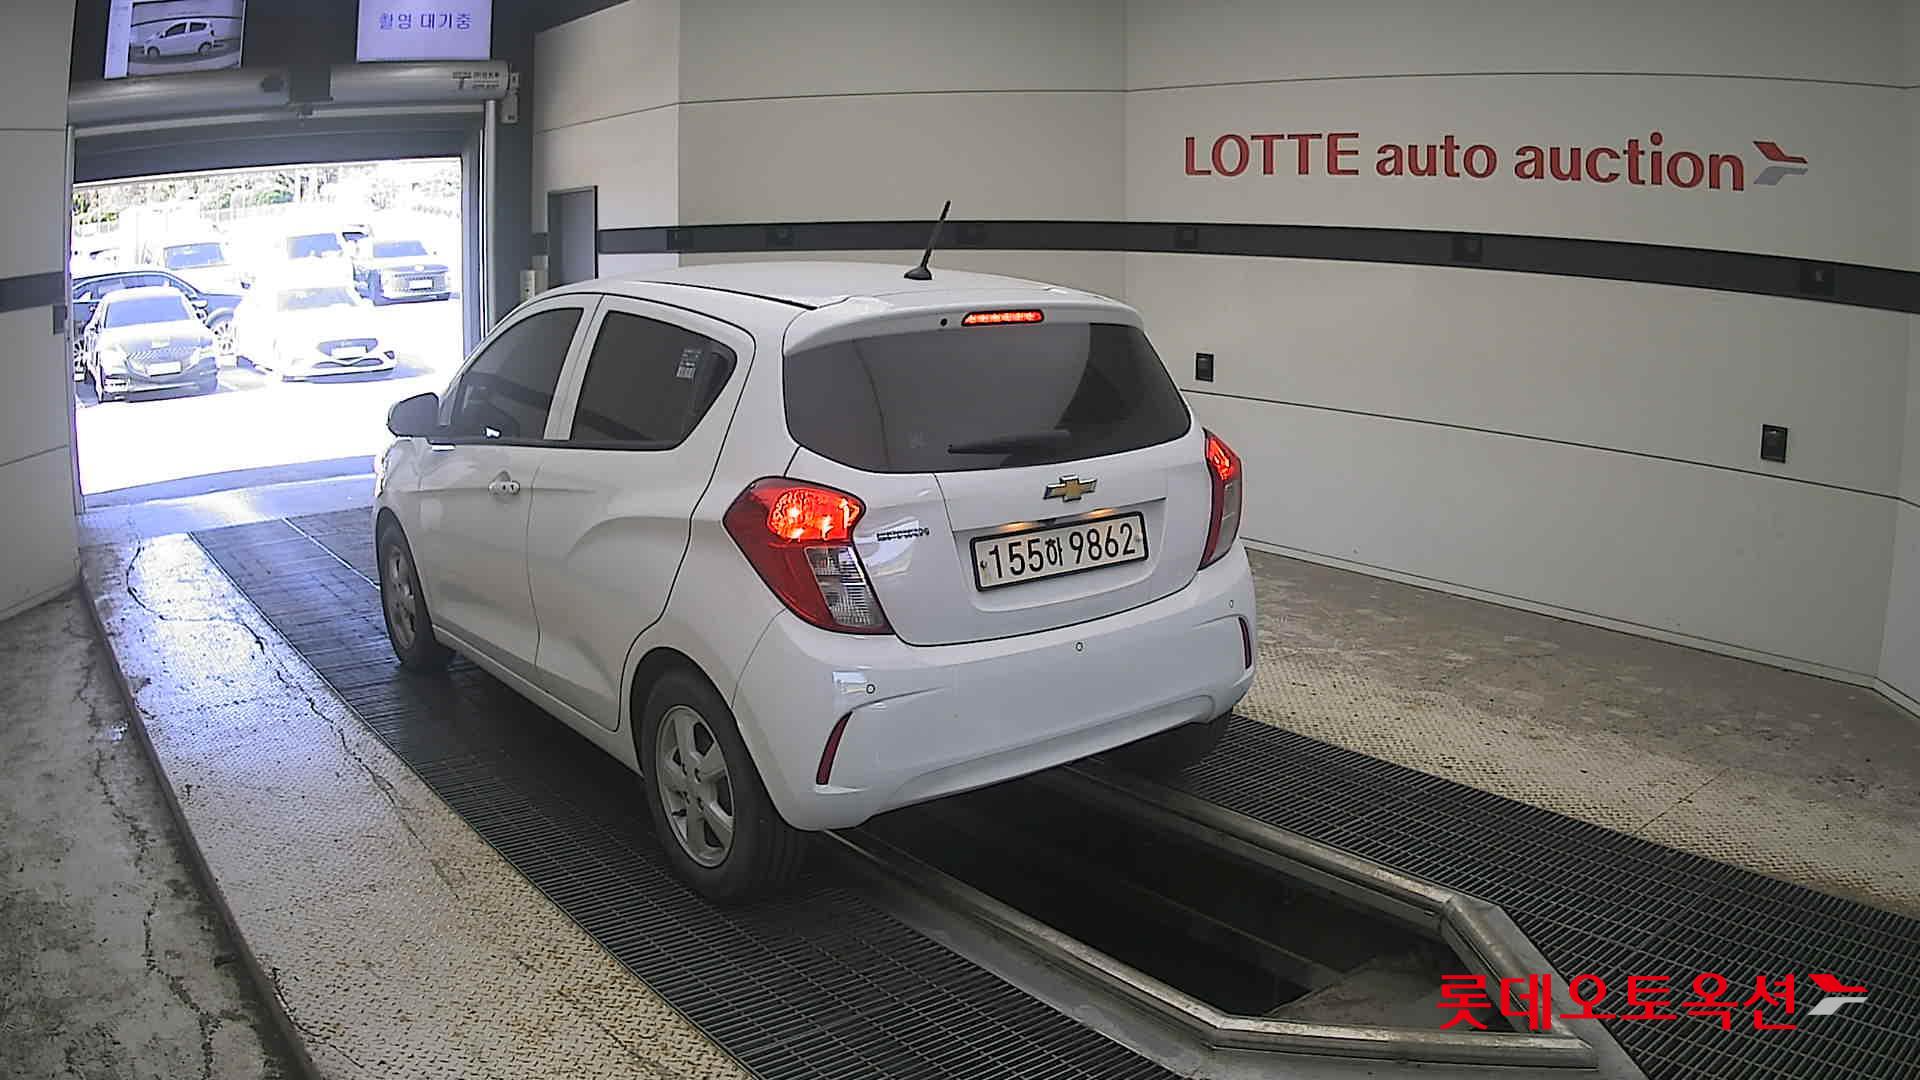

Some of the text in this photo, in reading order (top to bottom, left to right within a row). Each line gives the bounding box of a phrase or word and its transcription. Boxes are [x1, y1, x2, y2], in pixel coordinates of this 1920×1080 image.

[420, 12, 473, 30] 대기중
[1184, 131, 1746, 191] LOTTE auto auction
[989, 522, 1136, 579] 155하 9862
